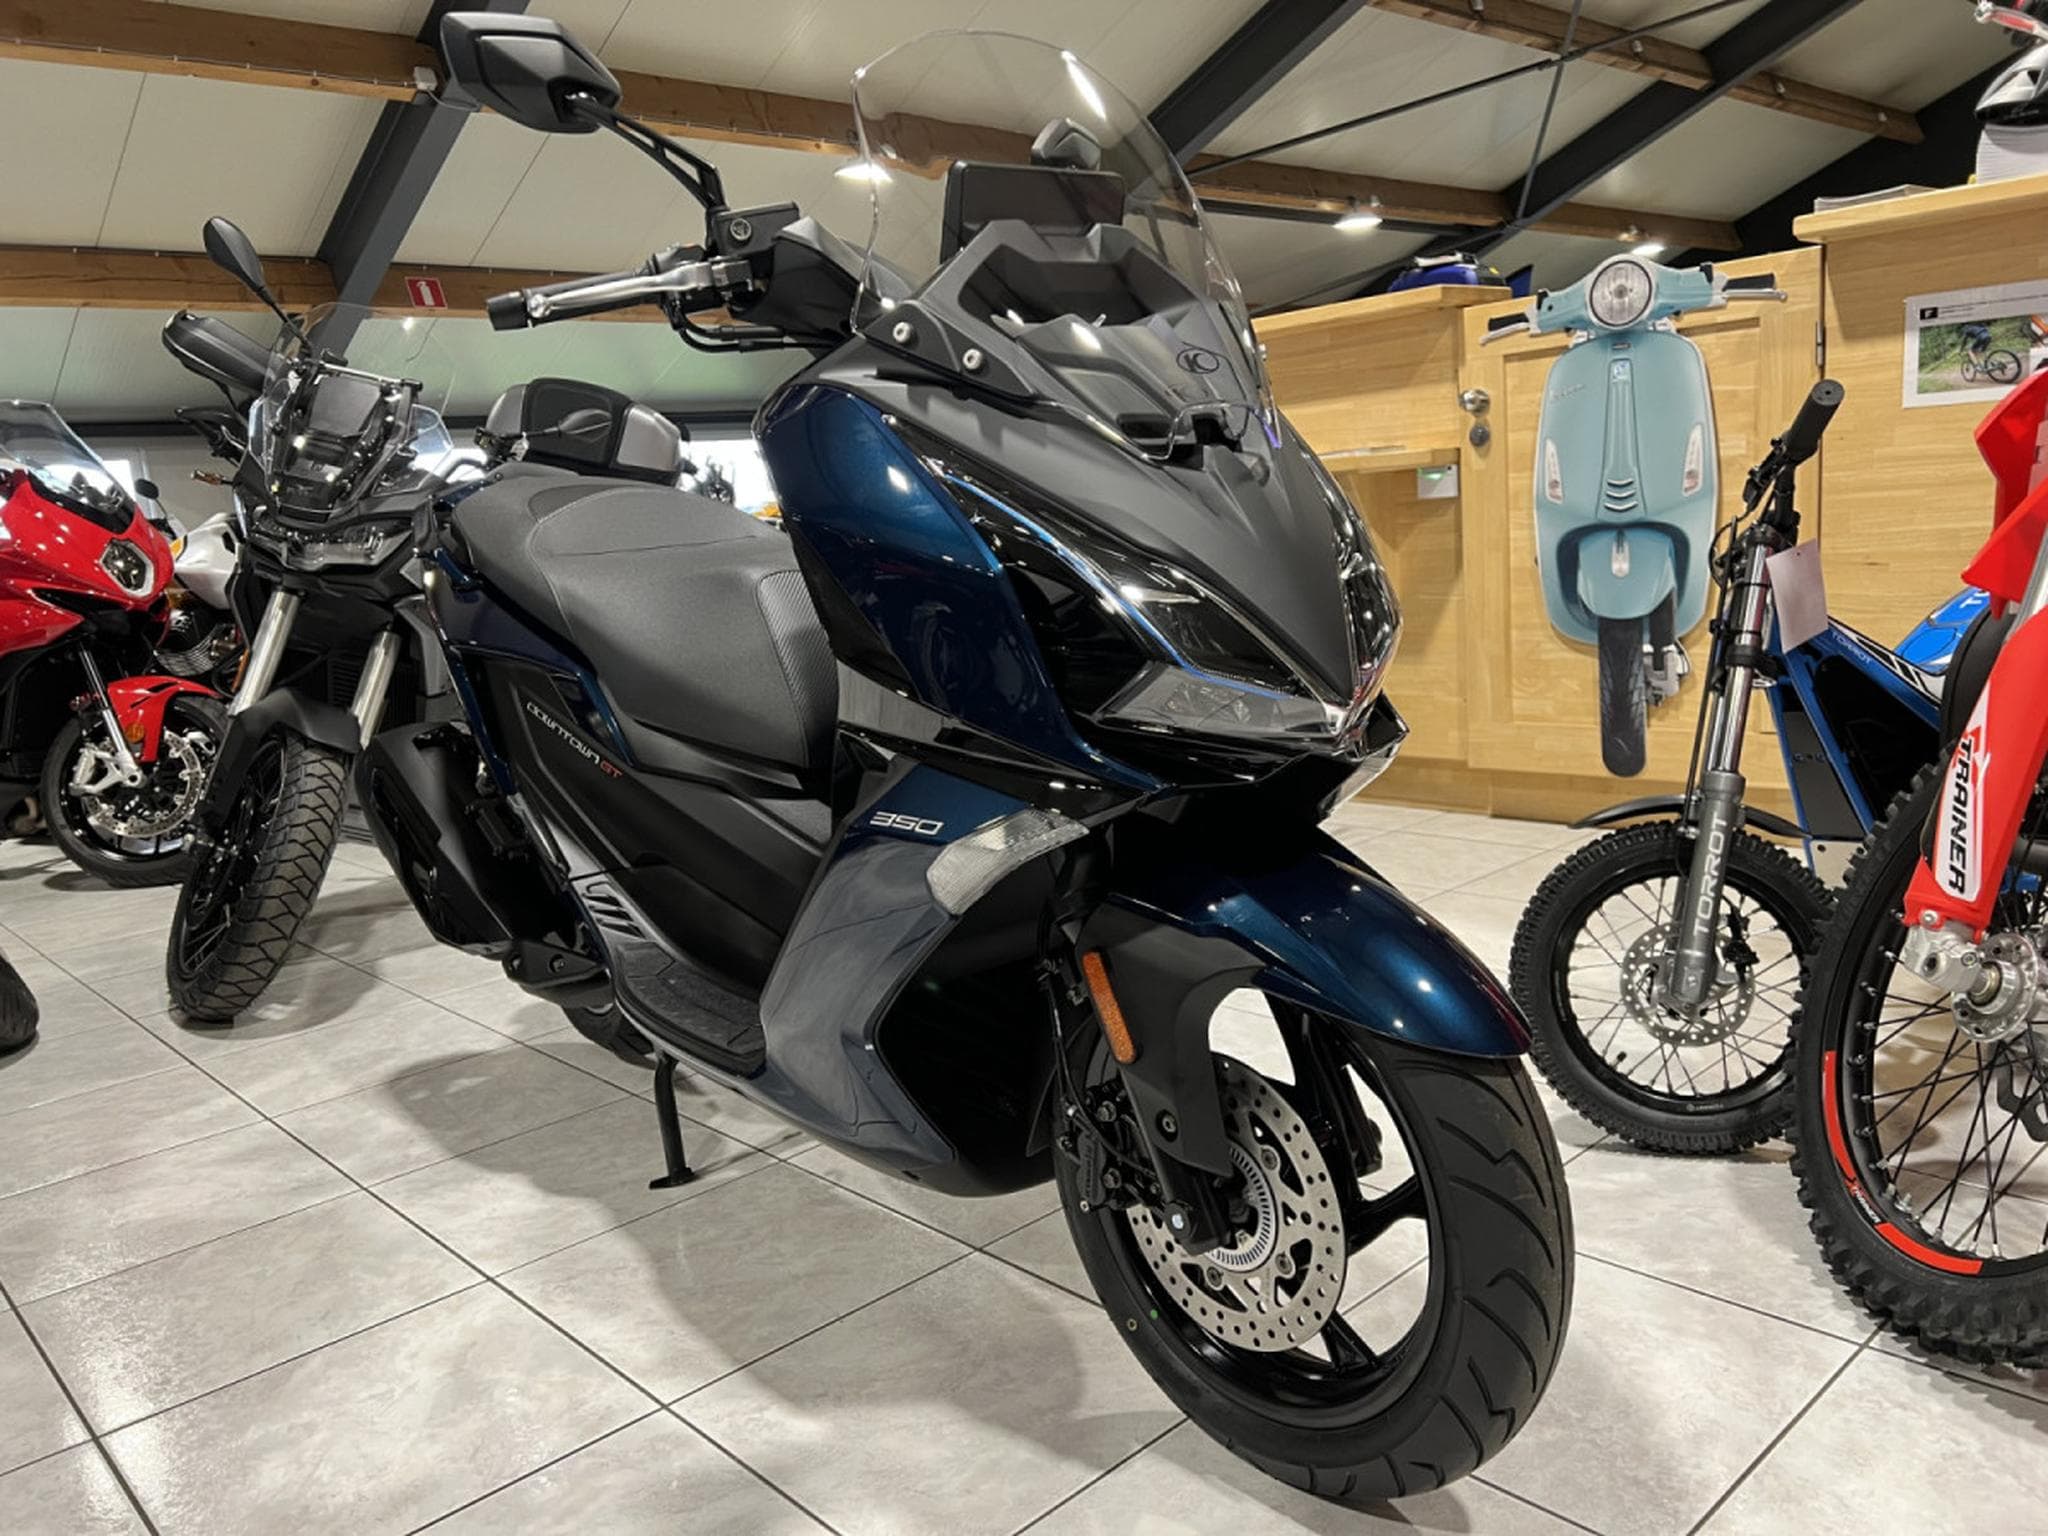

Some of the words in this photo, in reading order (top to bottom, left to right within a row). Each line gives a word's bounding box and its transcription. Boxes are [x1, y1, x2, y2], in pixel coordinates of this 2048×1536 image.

[600, 760, 623, 778] GT
[869, 811, 944, 836] 350
[1948, 737, 1973, 896] TRAINER
[1693, 811, 1727, 937] TORROT
